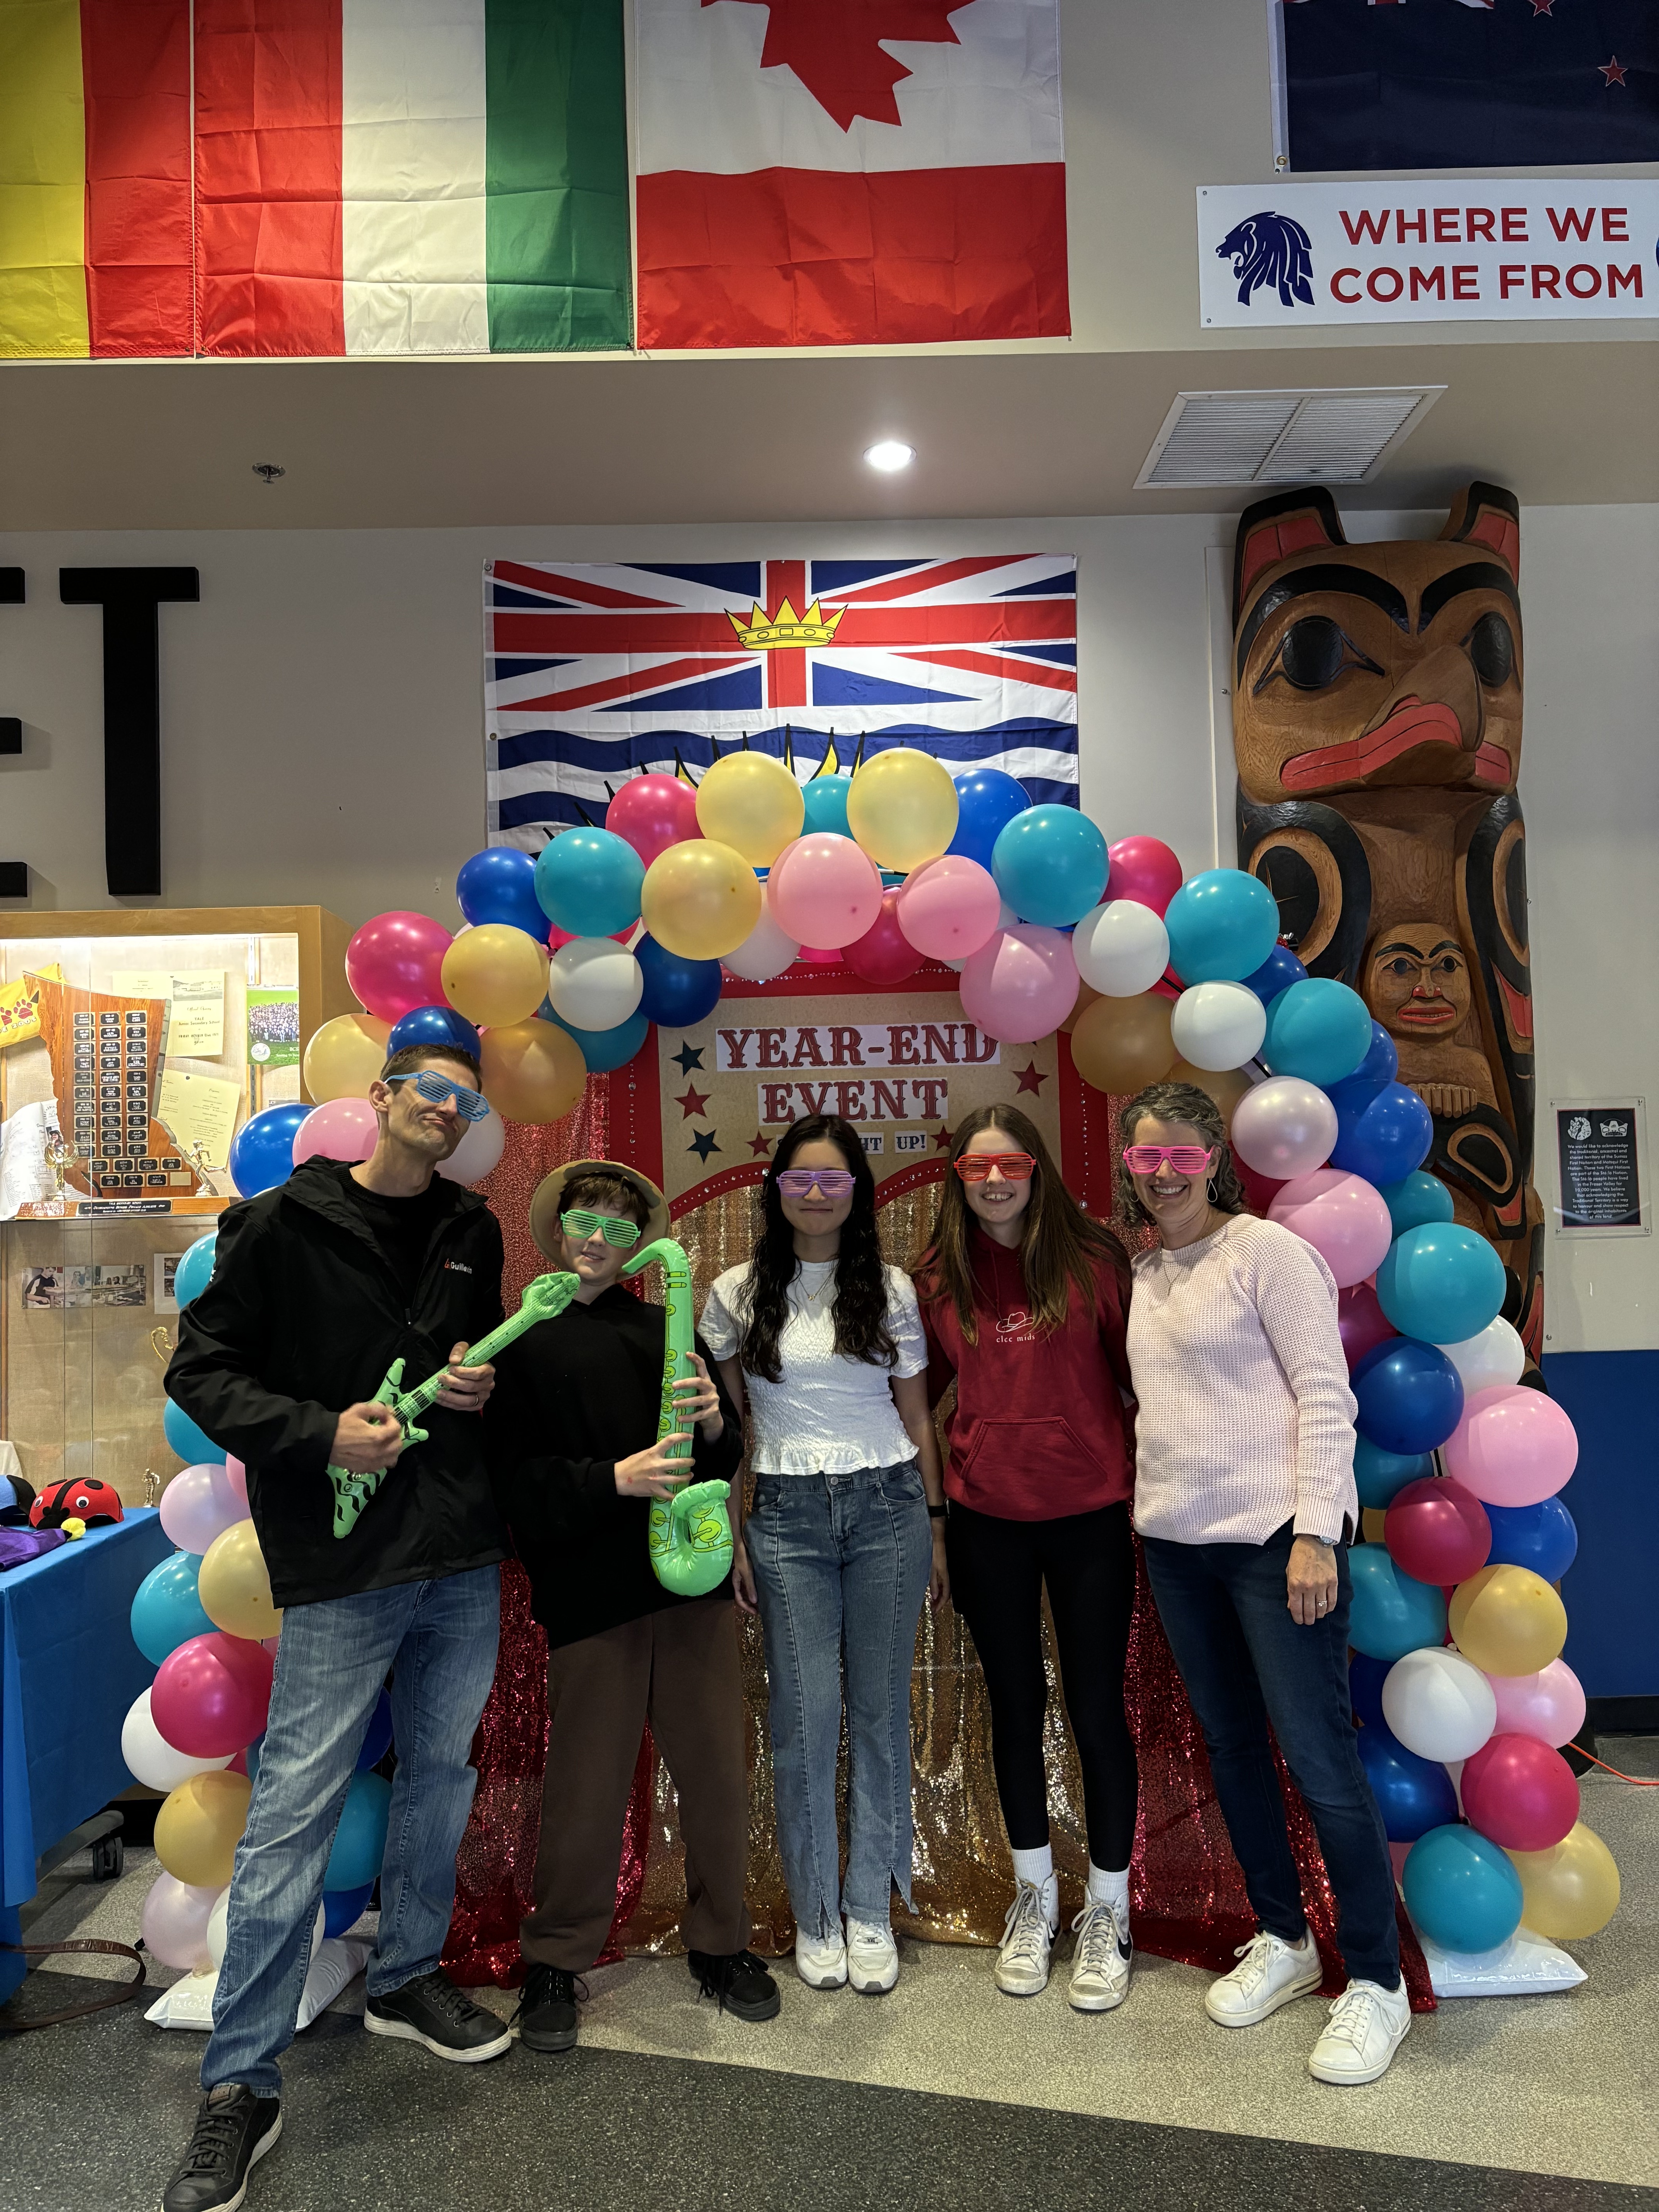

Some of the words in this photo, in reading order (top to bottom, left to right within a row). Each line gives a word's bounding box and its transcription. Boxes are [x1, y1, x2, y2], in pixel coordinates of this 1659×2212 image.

[1338, 208, 1529, 246] WHERE
[1546, 207, 1629, 242] WE
[1330, 266, 1480, 304] COME
[1500, 263, 1643, 299] FROM
[718, 1023, 998, 1068] YEAR-END
[761, 1079, 948, 1123] EVENT
[896, 1135, 926, 1149] UP!
[1017, 1333, 1035, 1341] mids
